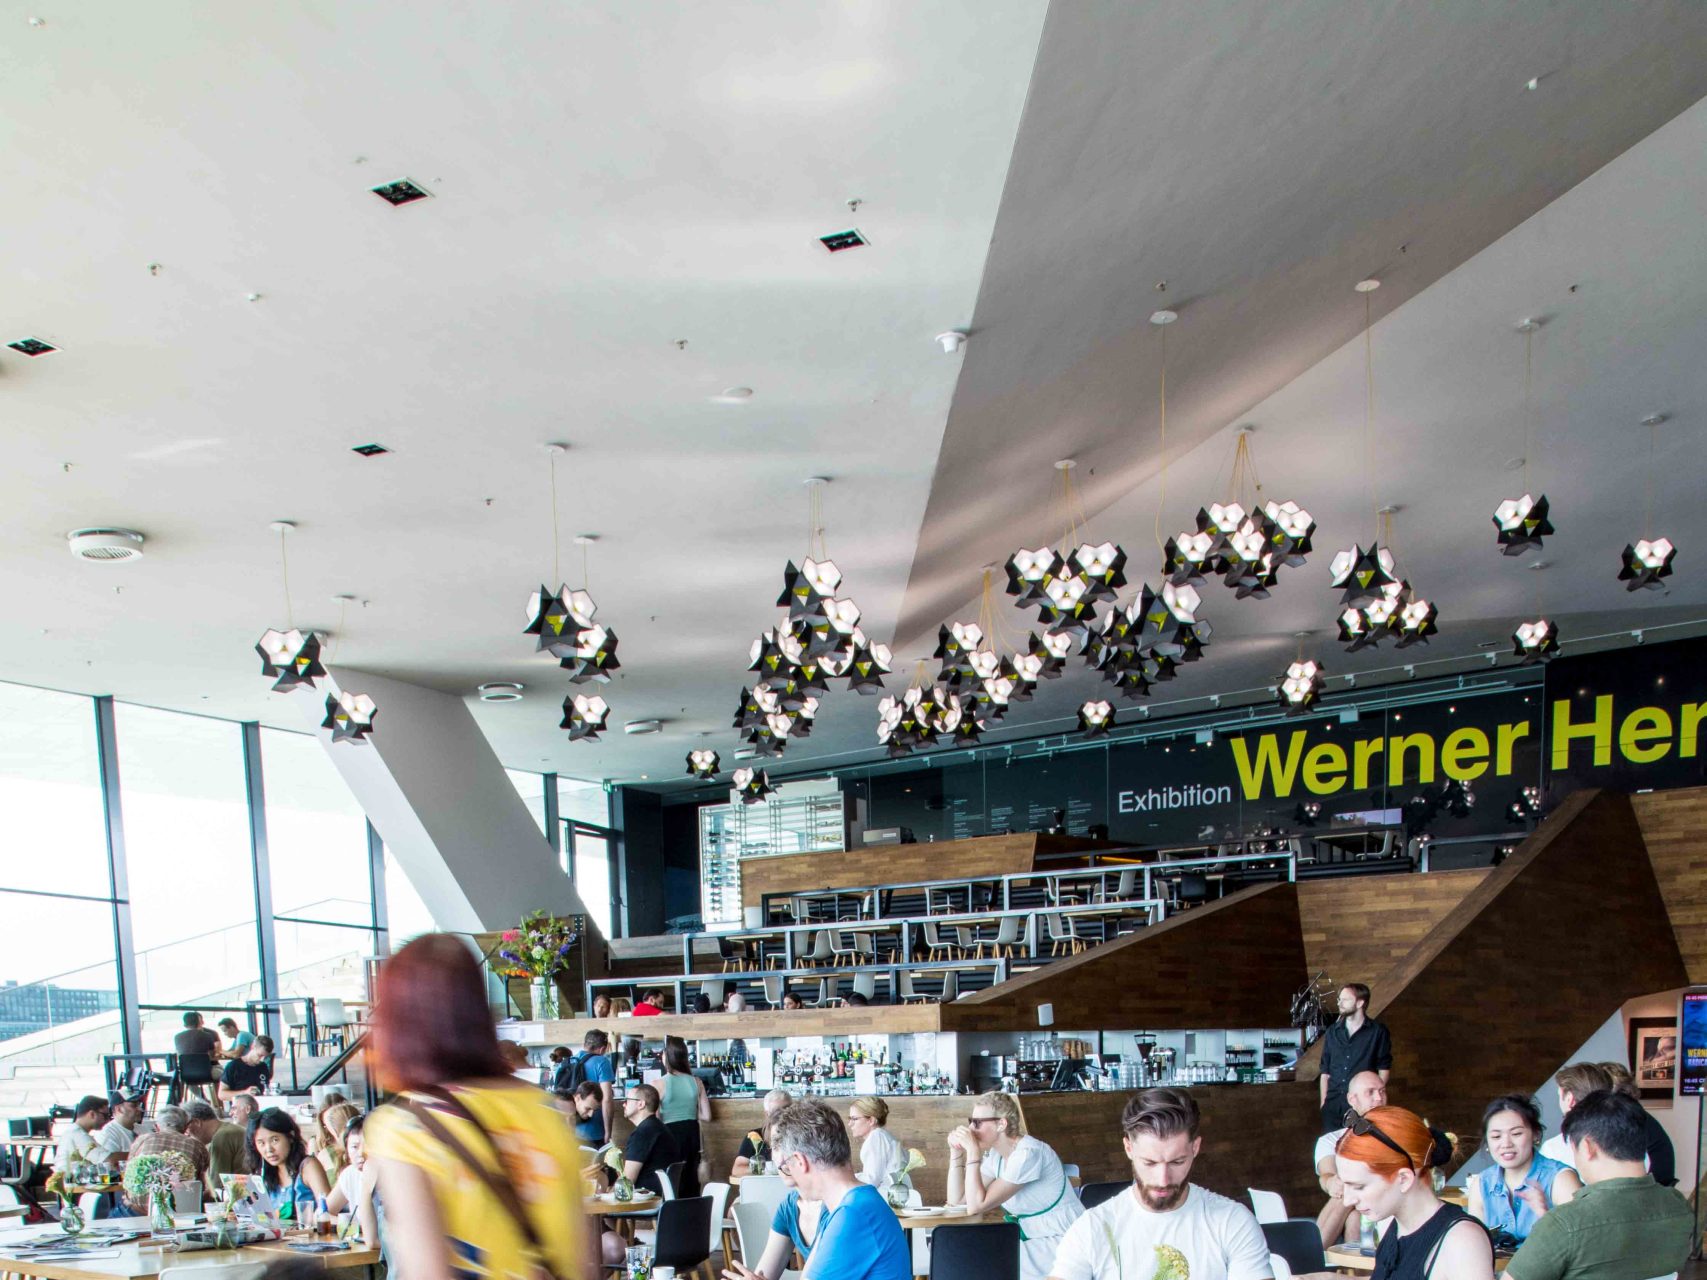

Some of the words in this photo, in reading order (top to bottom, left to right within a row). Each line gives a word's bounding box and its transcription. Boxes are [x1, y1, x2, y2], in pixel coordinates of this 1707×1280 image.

[1230, 721, 1529, 801] Werner
[1552, 694, 1707, 771] Her
[1119, 784, 1231, 813] Exhibition
